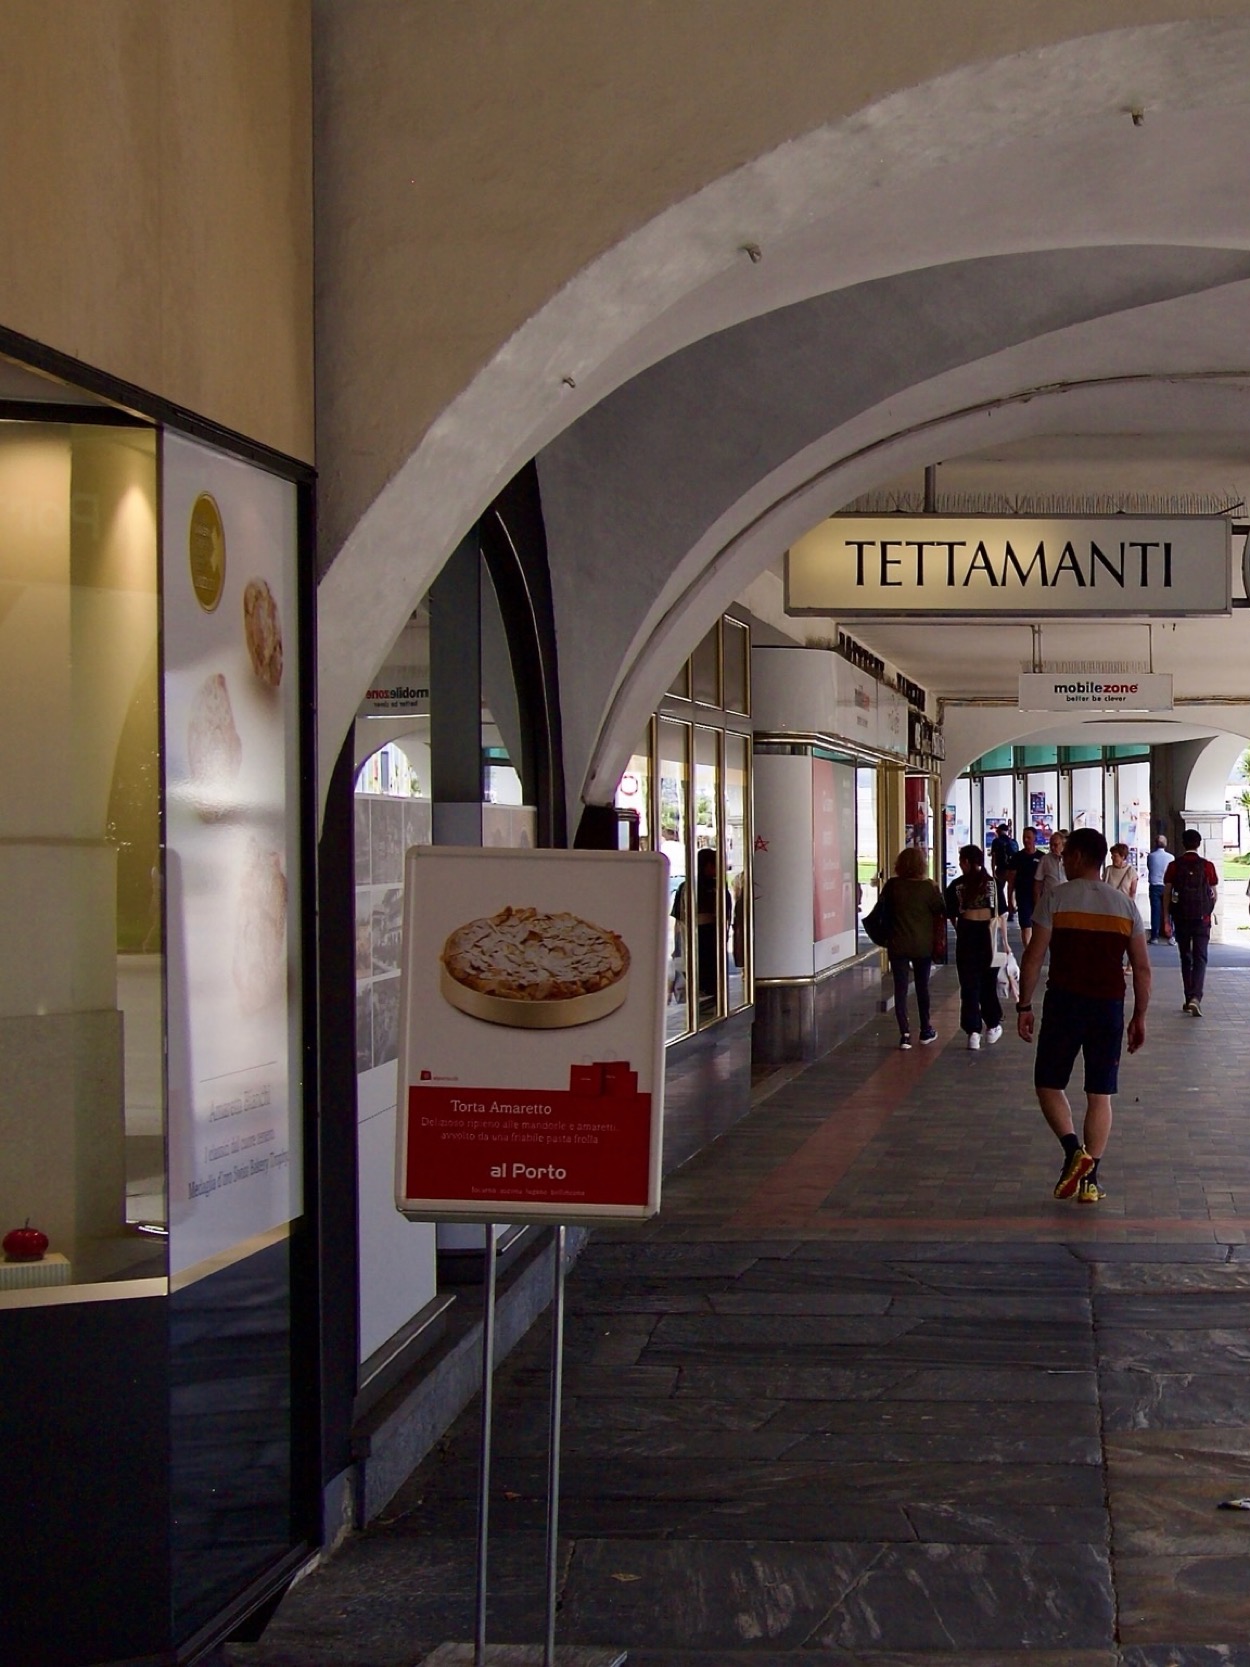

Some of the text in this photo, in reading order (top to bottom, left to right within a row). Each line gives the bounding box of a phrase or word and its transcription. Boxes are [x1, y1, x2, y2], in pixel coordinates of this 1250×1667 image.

[844, 540, 1175, 588] TETTAMANTI
[1054, 682, 1138, 693] mobilezone
[450, 1099, 552, 1115] Torta Amaretto
[490, 1163, 567, 1180] al Porto
